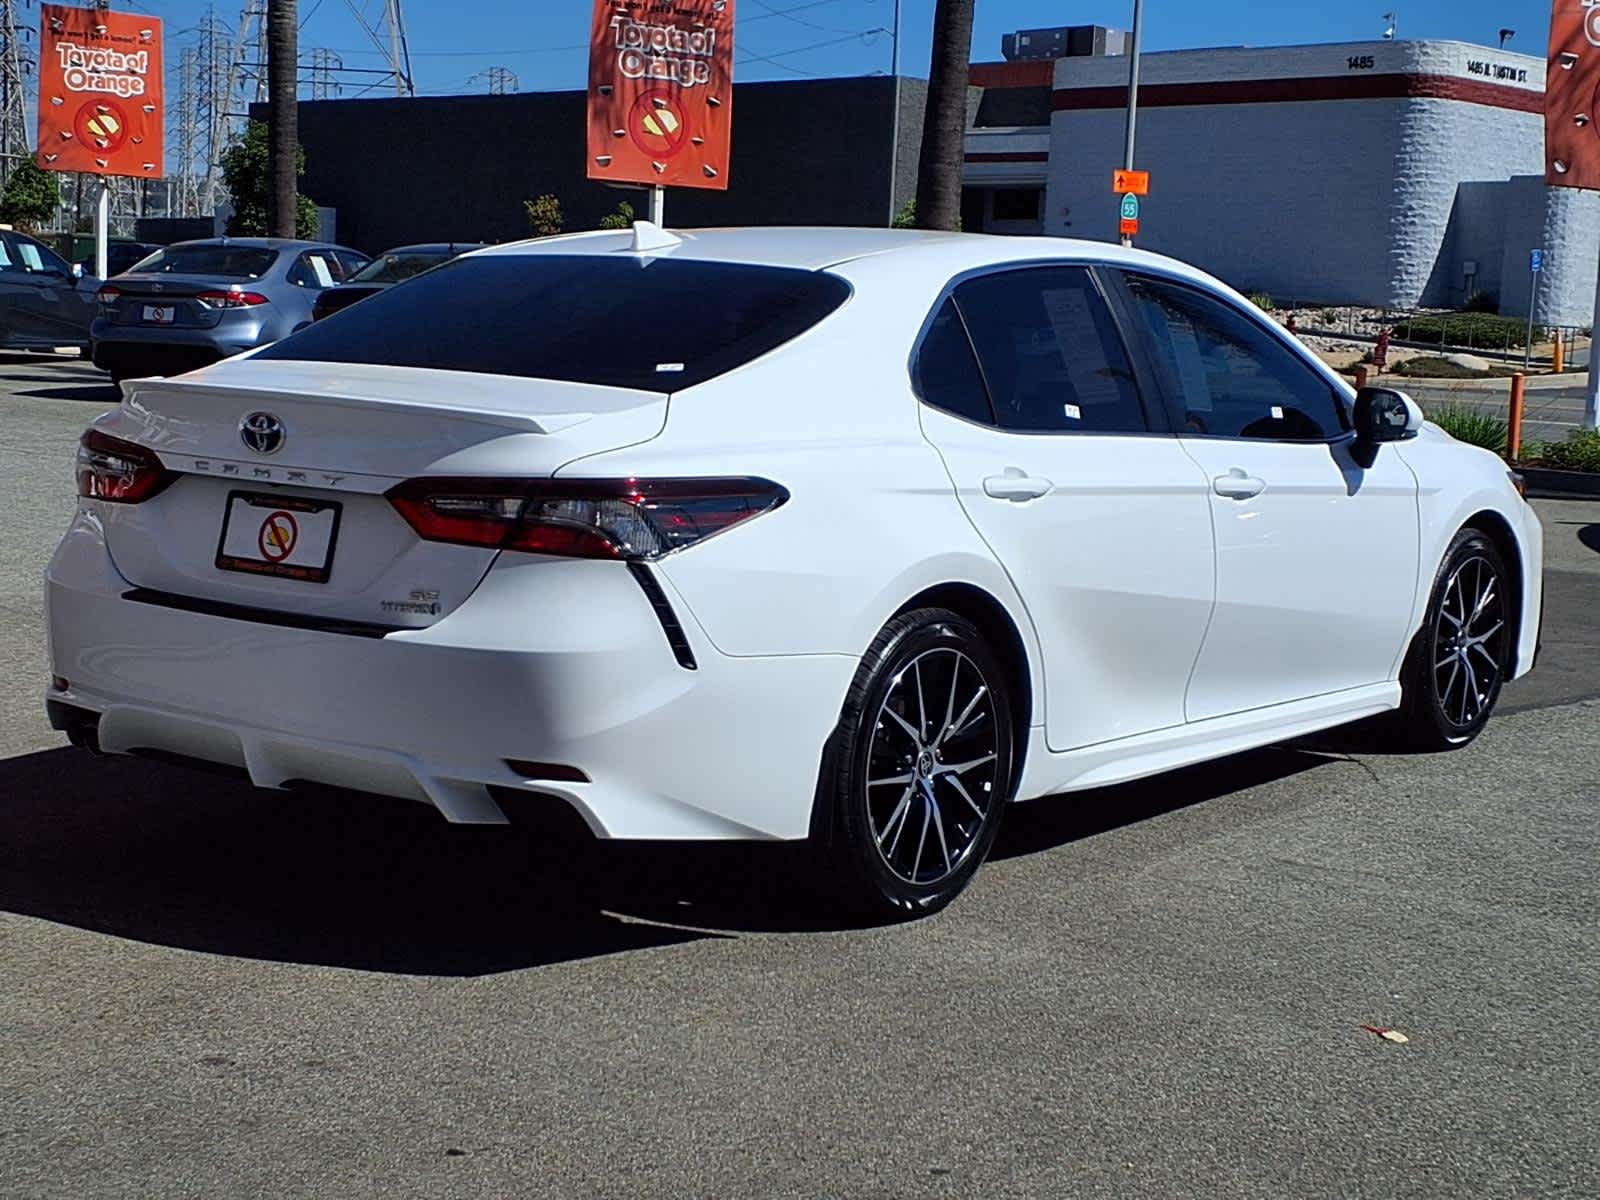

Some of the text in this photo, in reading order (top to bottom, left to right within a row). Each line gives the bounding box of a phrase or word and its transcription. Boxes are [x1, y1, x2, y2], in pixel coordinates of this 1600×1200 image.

[609, 15, 715, 56] Toyota of
[56, 42, 148, 74] Toyota of
[618, 49, 709, 87] Orange
[1346, 56, 1375, 70] 1485
[1467, 60, 1483, 75] 1485
[64, 67, 144, 97] Orange
[1124, 203, 1135, 216] 55
